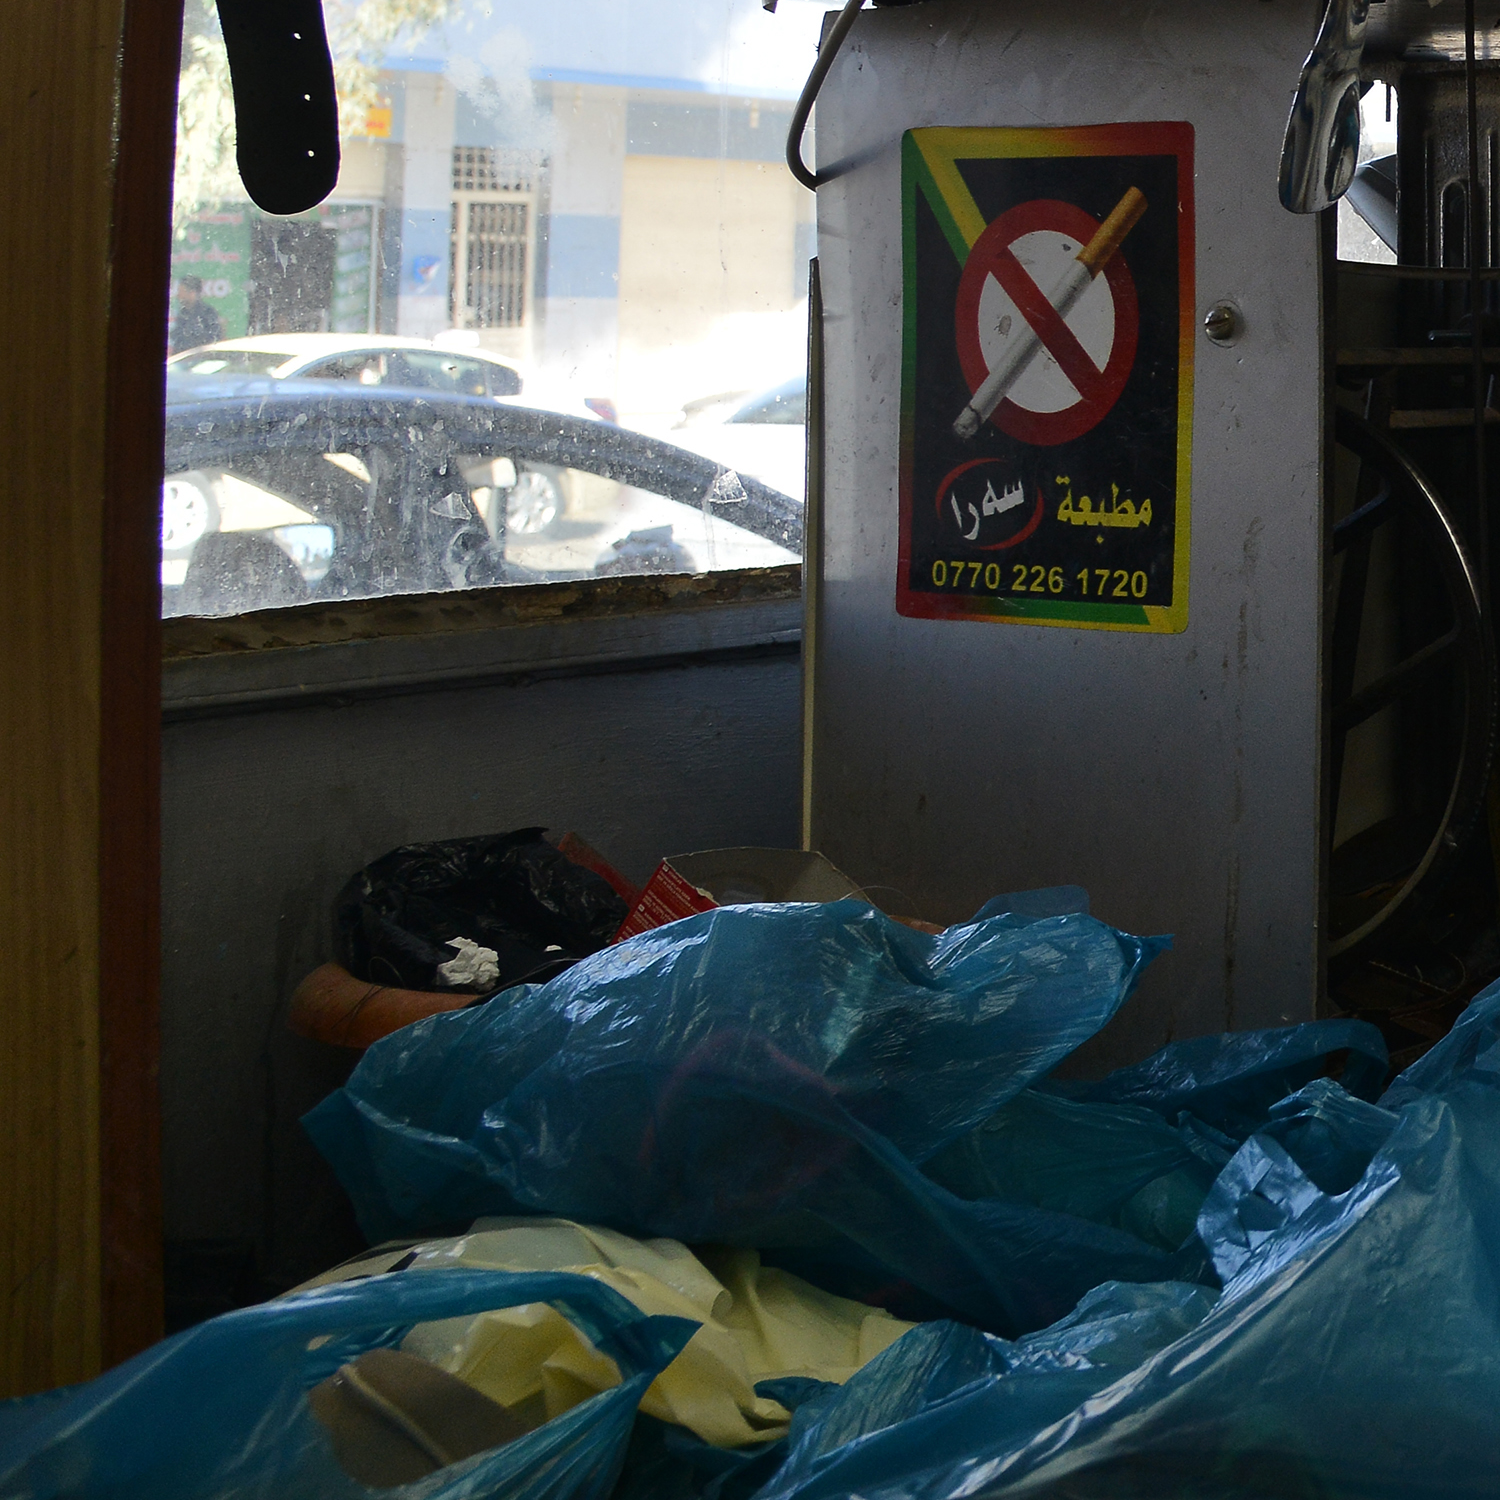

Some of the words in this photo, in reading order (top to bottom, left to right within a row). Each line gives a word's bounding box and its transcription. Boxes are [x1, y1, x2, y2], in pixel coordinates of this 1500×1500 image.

[1055, 475, 1153, 544] مطبعة
[932, 559, 1001, 590] 0770
[1011, 564, 1064, 594] 226
[1077, 567, 1149, 598] 1720
